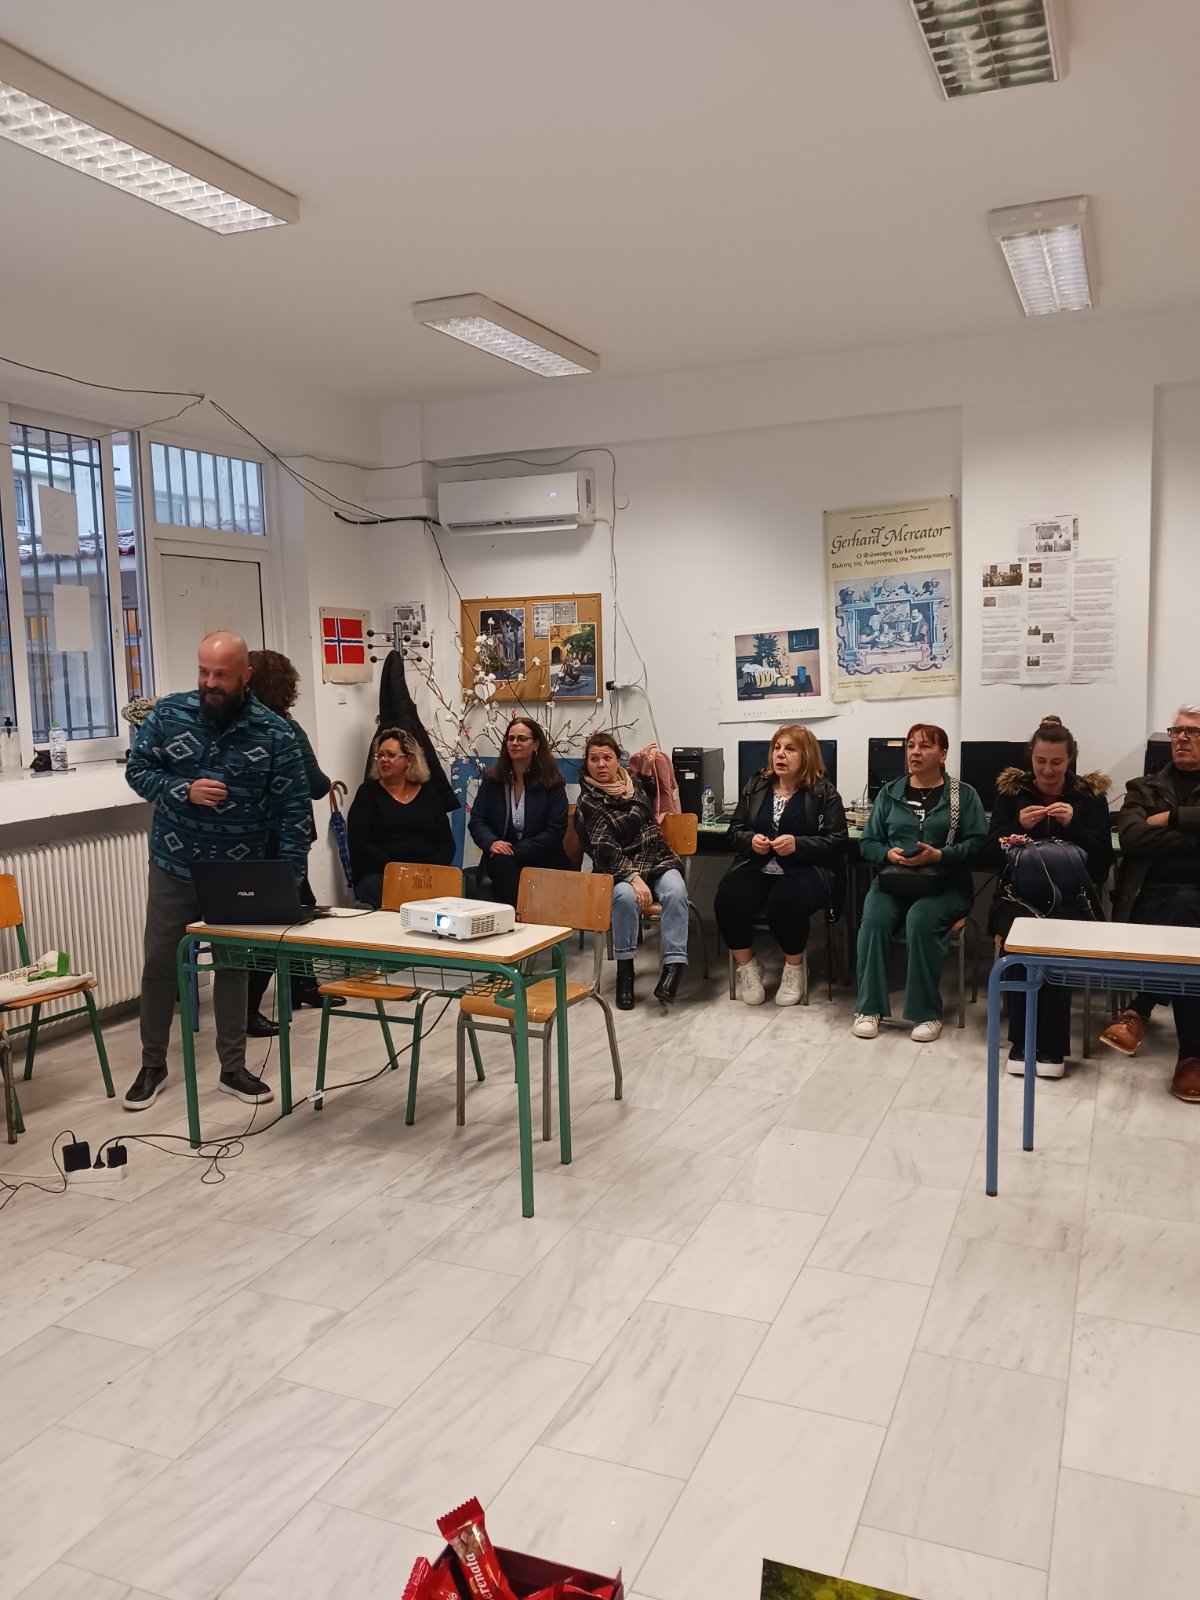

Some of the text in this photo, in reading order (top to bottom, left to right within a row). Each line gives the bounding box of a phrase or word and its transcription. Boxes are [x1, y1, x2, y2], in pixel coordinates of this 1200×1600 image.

[831, 524, 951, 554] Gerhard Mercator
[465, 1552, 496, 1600] erenata
